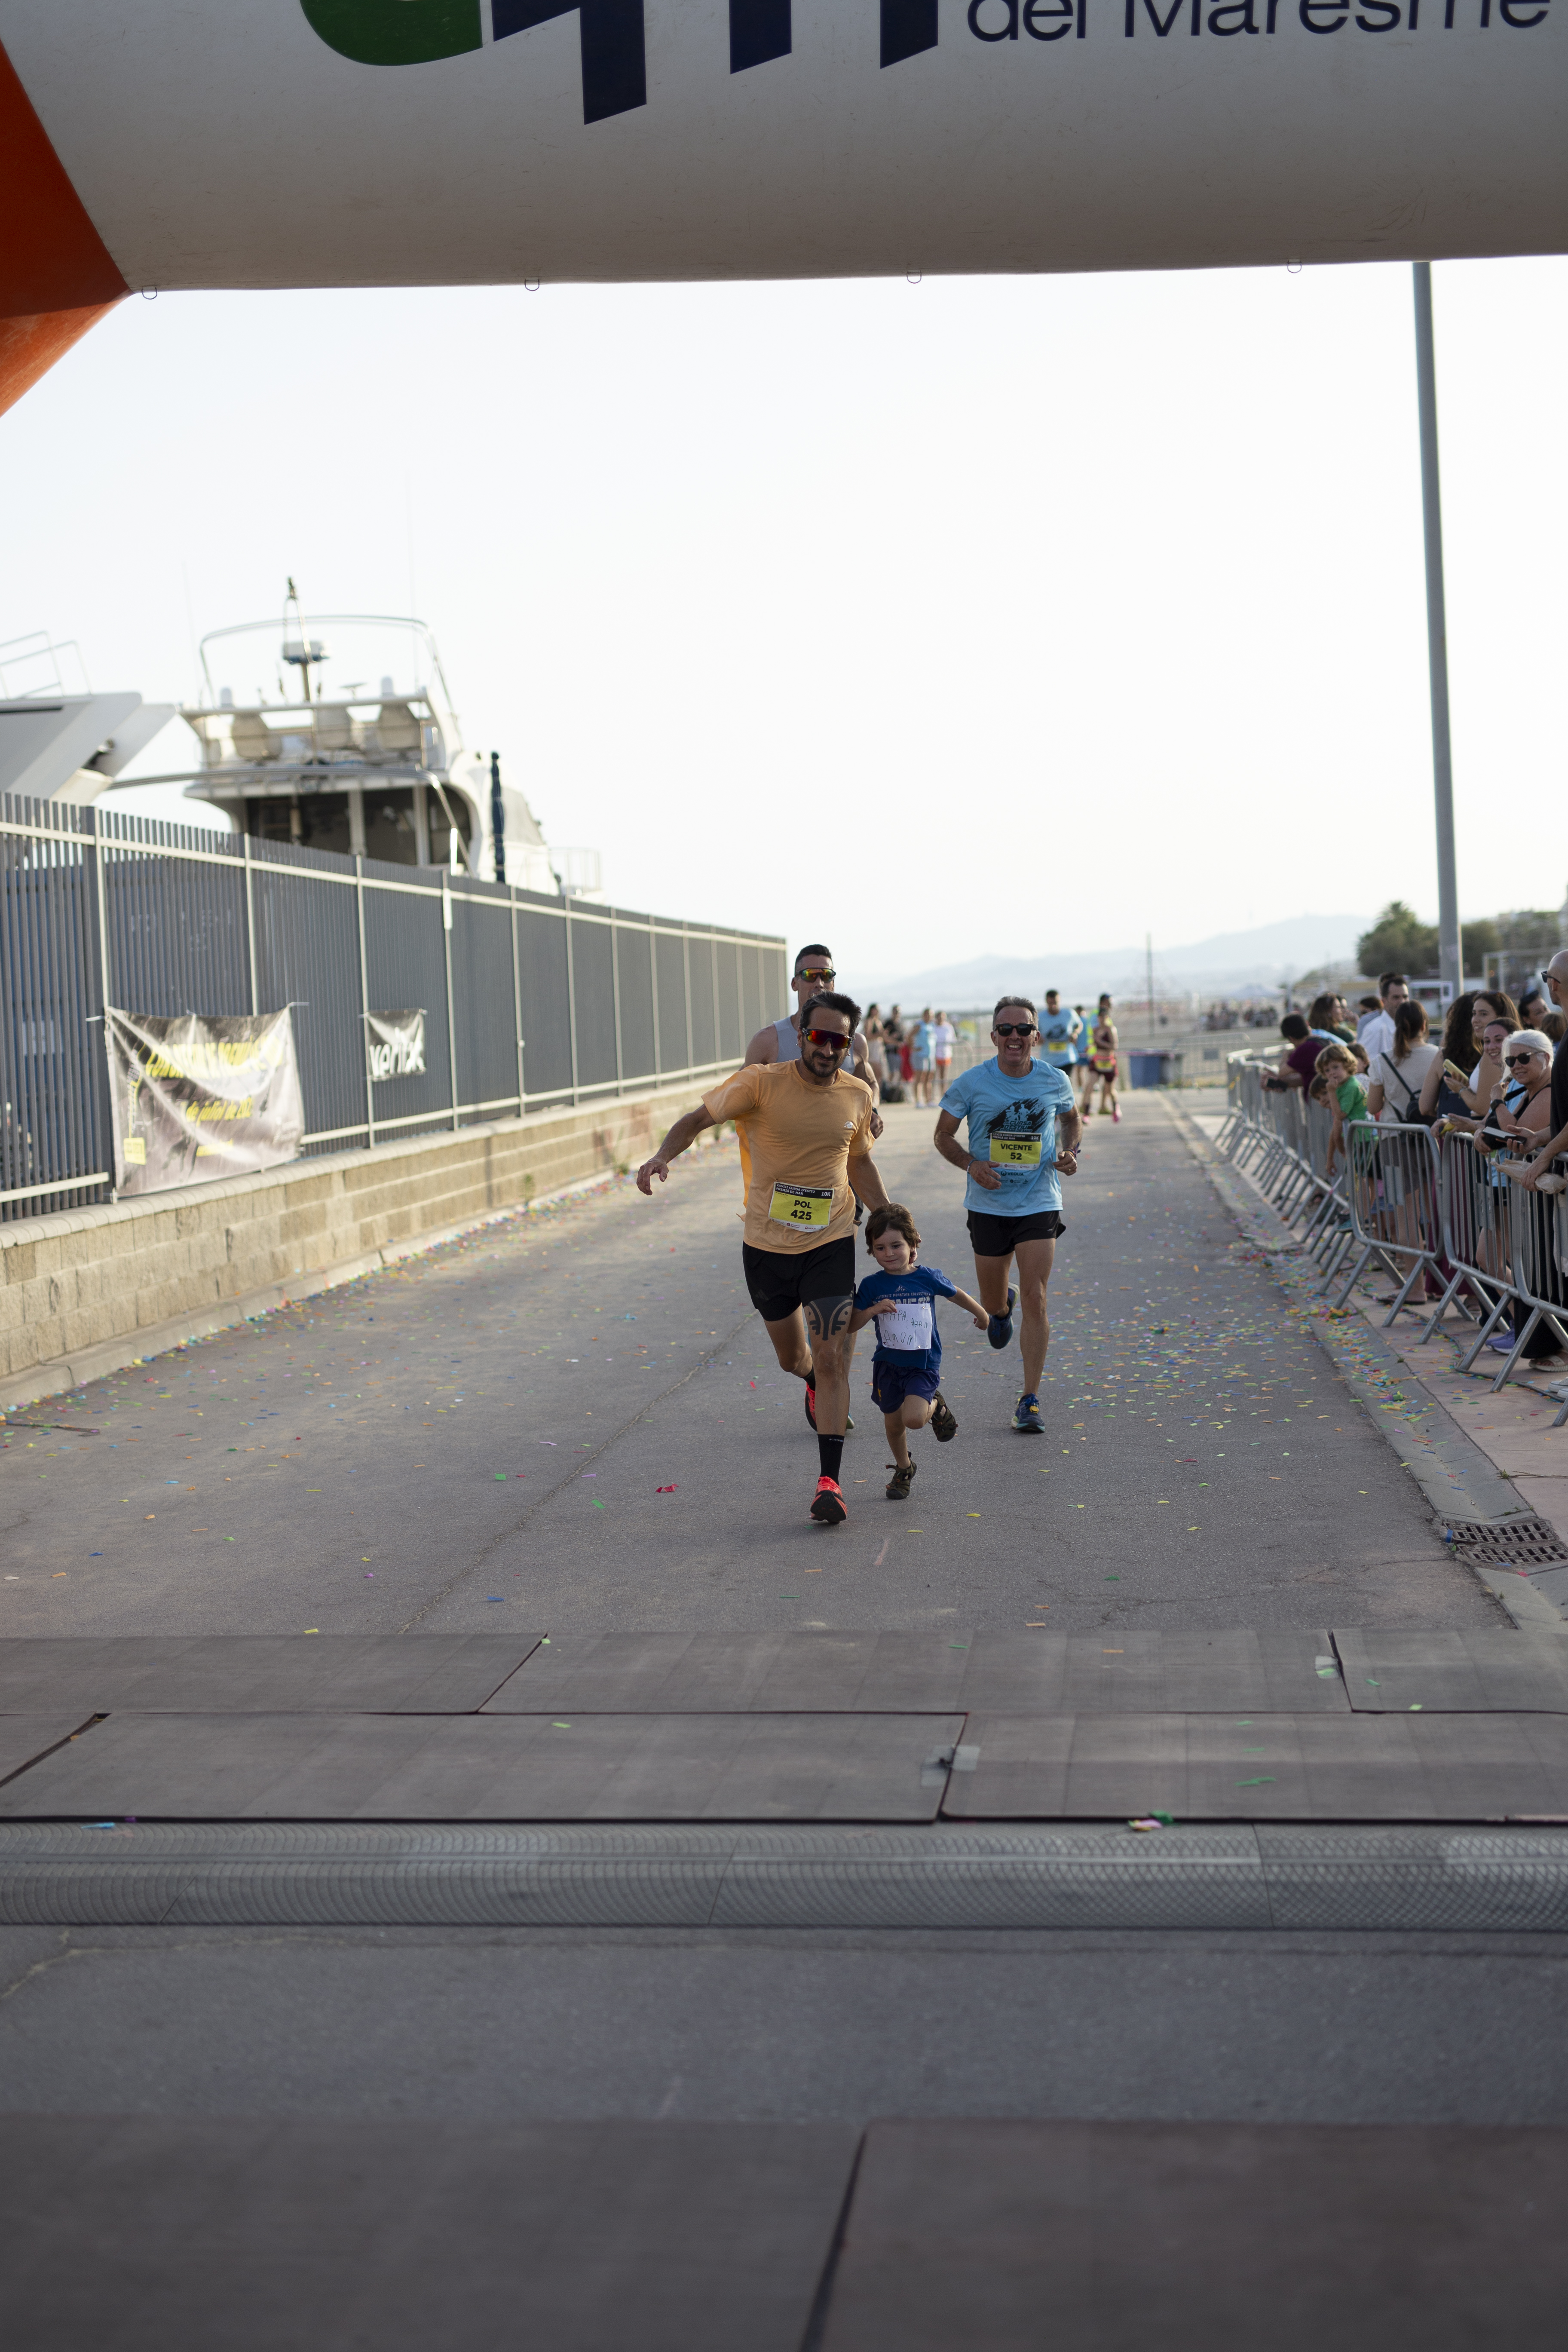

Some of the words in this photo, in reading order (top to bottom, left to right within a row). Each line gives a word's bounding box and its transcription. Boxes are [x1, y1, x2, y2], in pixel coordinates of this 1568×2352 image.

[1124, 0, 1549, 38] Maresme
[1010, 1152, 1022, 1160] 52
[794, 1200, 812, 1209] POL
[790, 1209, 812, 1221] 425
